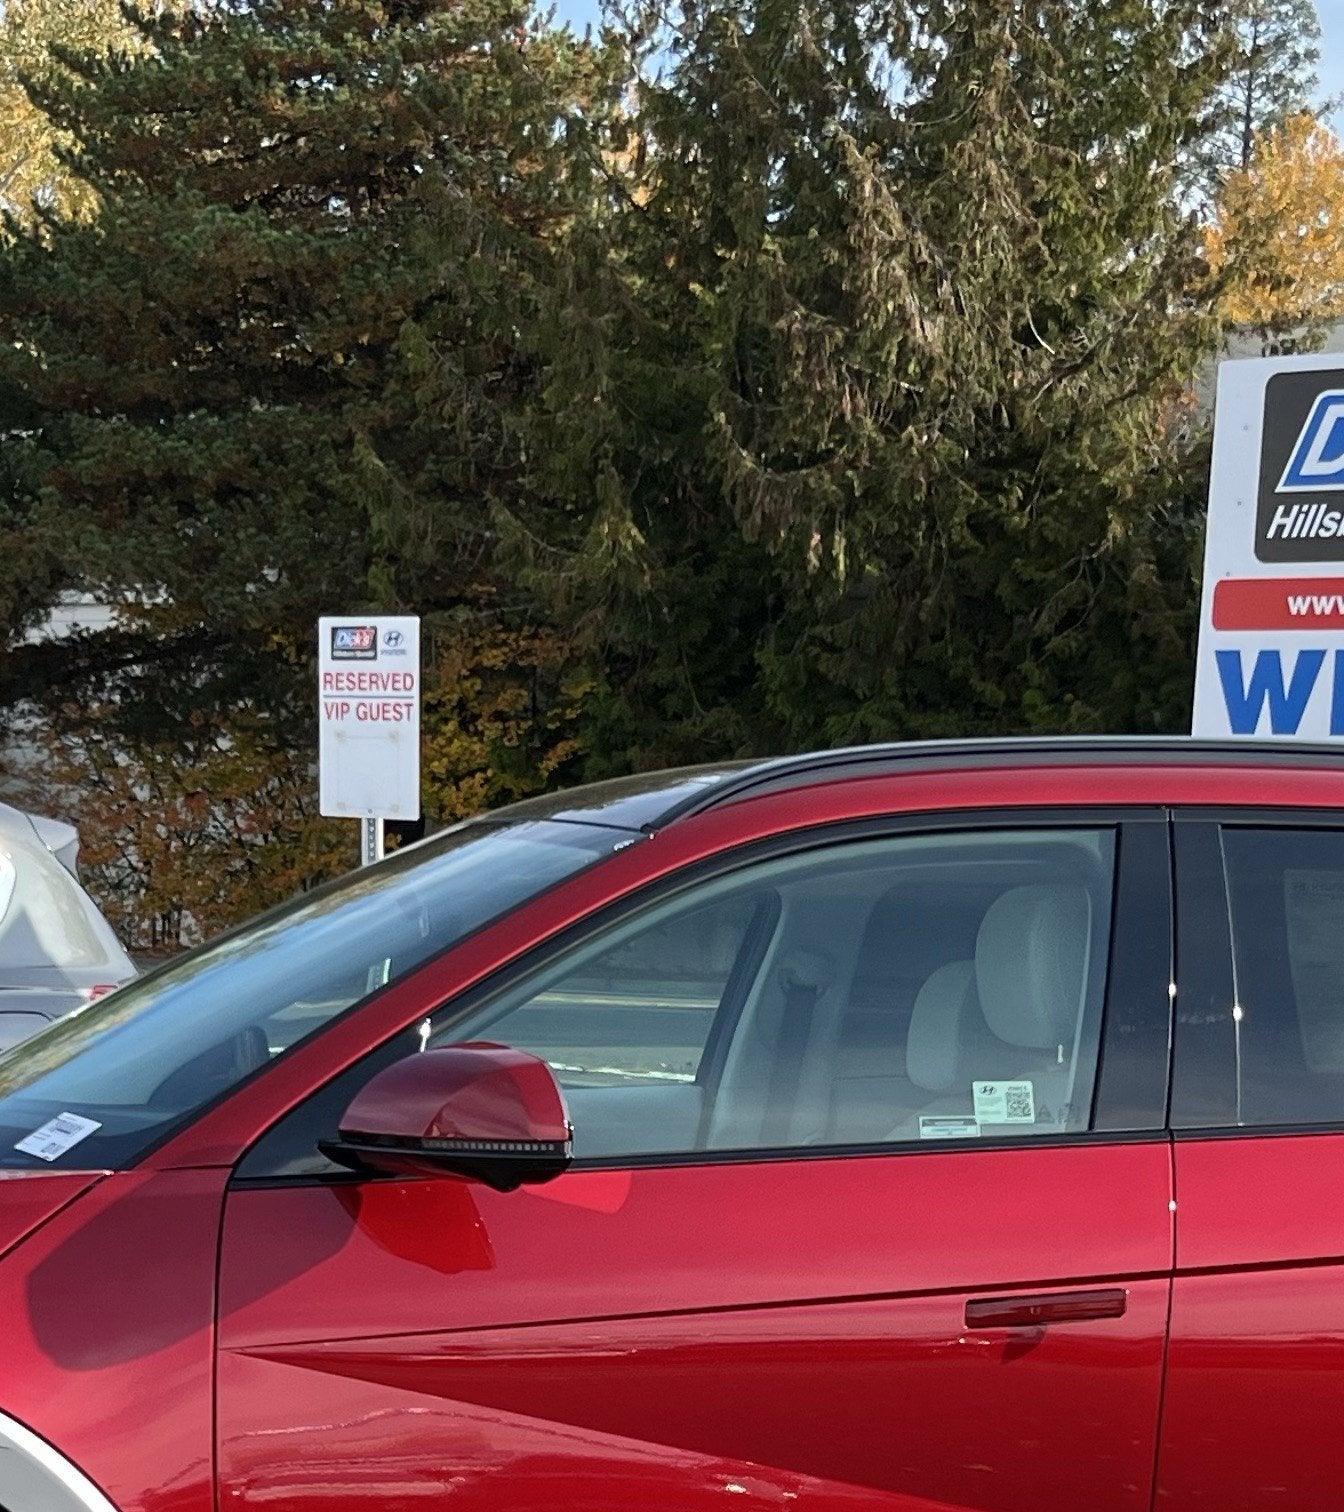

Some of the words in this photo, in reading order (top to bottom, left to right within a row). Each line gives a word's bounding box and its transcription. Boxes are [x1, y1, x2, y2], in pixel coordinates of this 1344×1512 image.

[323, 672, 415, 691] RESERVED
[324, 702, 350, 721] VIP
[356, 702, 414, 722] GUEST
